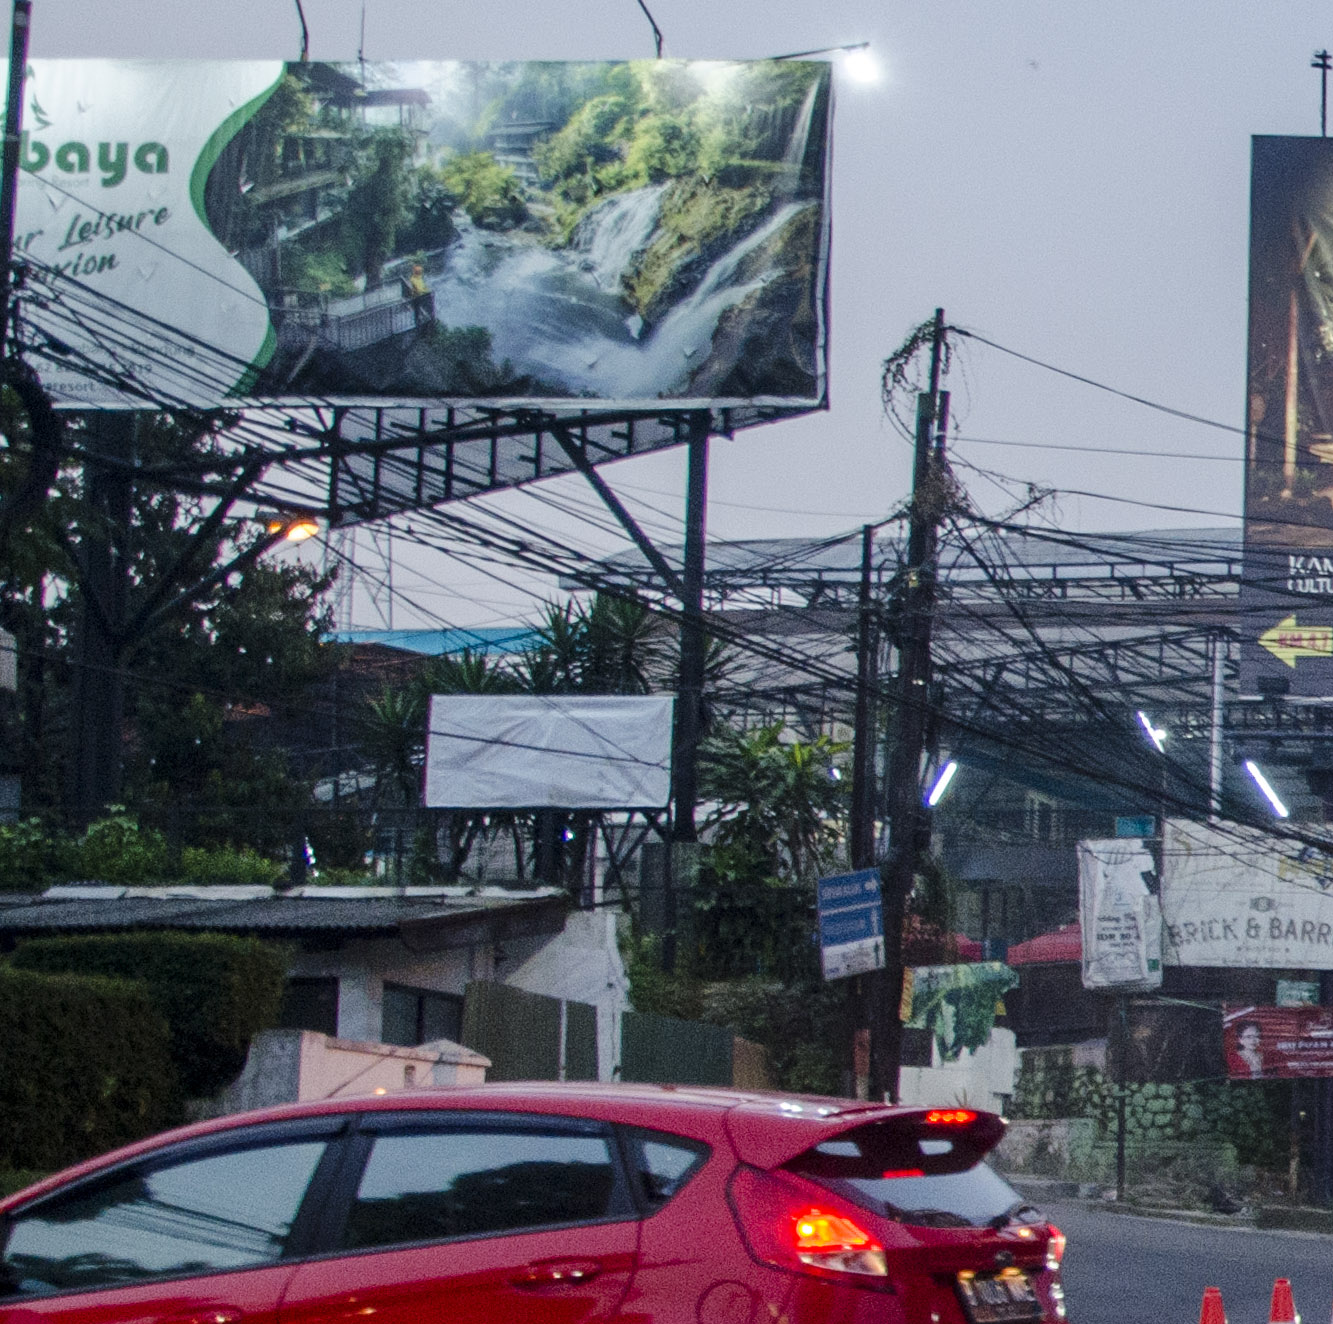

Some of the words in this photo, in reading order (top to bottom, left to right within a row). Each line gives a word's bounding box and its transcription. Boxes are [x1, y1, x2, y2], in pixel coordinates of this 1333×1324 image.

[58, 206, 172, 252] Leisure
[1168, 915, 1240, 947] BRICK
[1245, 916, 1261, 940] &
